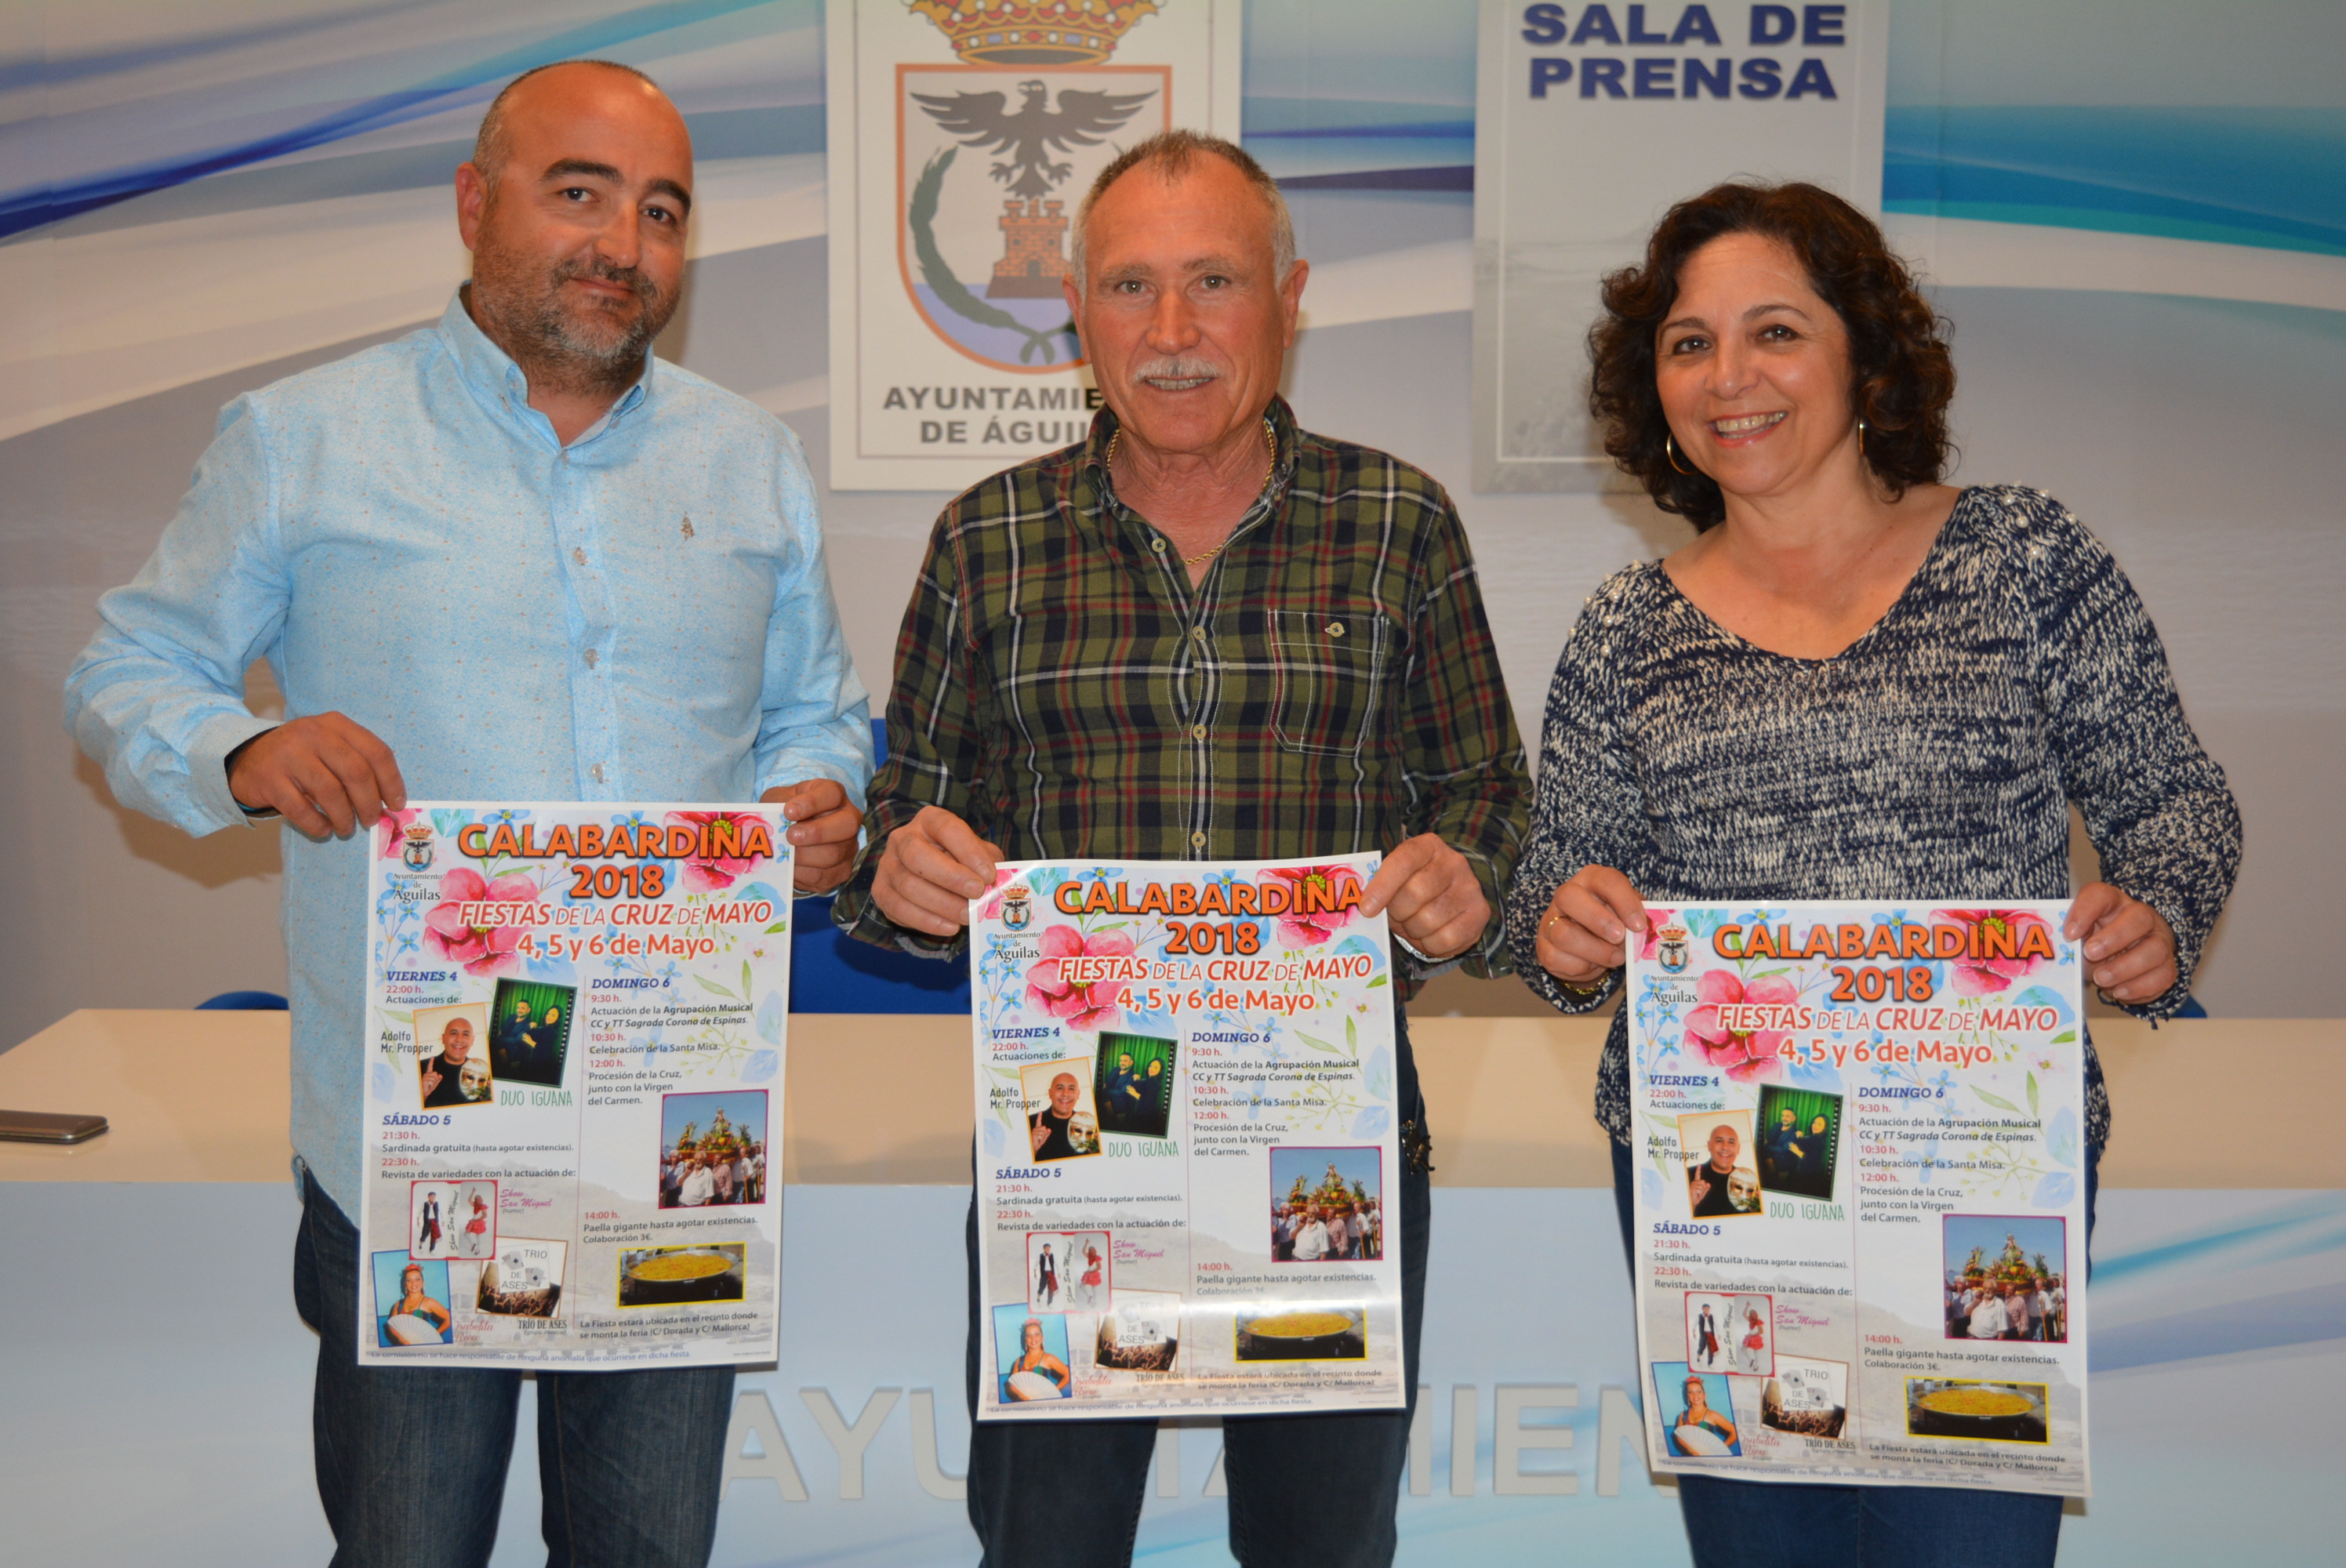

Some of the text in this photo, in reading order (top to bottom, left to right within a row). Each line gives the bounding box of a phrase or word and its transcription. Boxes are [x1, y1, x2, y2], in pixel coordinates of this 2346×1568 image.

[1522, 3, 1846, 45] SALA DE
[1530, 58, 1838, 99] PRENSA
[884, 387, 1106, 410] AYUNTAMIE
[921, 421, 967, 443] DE
[458, 823, 773, 858] CALABARDINA
[569, 864, 665, 898] 2018
[1055, 877, 1364, 916] CALABARDINA
[459, 902, 772, 925] FIESTAS DE LA CRUZ DE MAYO
[1165, 921, 1260, 955] 2018
[1713, 924, 2054, 960] CALABARDINA
[518, 934, 714, 960] 4, 5 y 6 de Mayo
[1060, 956, 1371, 981] FIESTAS DE LA CRUZ DE MAYO
[387, 971, 457, 981] VIERNES 4
[592, 978, 670, 989] DOMINGO 6
[1831, 966, 1933, 1001] 2018
[1118, 988, 1314, 1014] 4, 5 y 6 de Mayo
[1719, 1007, 2057, 1030] FIESTAS DE LA CRUZ DE MAYO
[381, 1032, 411, 1041] Adolfo
[993, 1027, 1060, 1039] VIERNES 4
[1192, 1033, 1270, 1043] DOMINGO 6
[381, 1044, 434, 1055] Mr. Propper
[1780, 1039, 1992, 1067] 4, 5 y 6 de Mayo
[1266, 1060, 1320, 1069] Agrupación
[1324, 1059, 1359, 1068] Musical
[1649, 1075, 1720, 1087] VIERNES 4
[501, 1091, 572, 1106] DUO IGUANA
[990, 1088, 1019, 1098] Adolfo
[1678, 1090, 1687, 1098] h.
[1858, 1087, 1944, 1098] DOMINGO 6
[990, 1100, 1040, 1110] Mr. Propper
[1193, 1098, 1247, 1106] Celebración
[1274, 1098, 1300, 1106] Santa
[1302, 1098, 1327, 1106] Misa.
[1650, 1100, 1725, 1109] Actuaciones de:
[1859, 1104, 1891, 1112] 9:30 h.
[383, 1112, 451, 1125] SÁBADO 5
[1647, 1137, 1676, 1146] Adolfo
[1109, 1141, 1178, 1157] DUO IGUANA
[1648, 1149, 1699, 1161] Mr. Propper
[432, 1170, 482, 1178] variedades
[504, 1169, 512, 1178] la
[997, 1167, 1061, 1179] SÁBADO 5
[500, 1189, 524, 1198] Show
[1861, 1187, 1908, 1196] Procesión
[1927, 1188, 1935, 1196] la
[1937, 1189, 1963, 1198] Cruz,
[500, 1199, 552, 1208] San Miguel
[997, 1196, 1043, 1205] Sardinada
[1046, 1196, 1081, 1206] gratuita
[1770, 1202, 1844, 1221] DUO IGUANA
[1654, 1221, 1720, 1235] SÁBADO 5
[525, 1250, 547, 1259] TRIO
[502, 1281, 528, 1290] ASES
[537, 1320, 547, 1329] DE
[1865, 1334, 1902, 1344] 14:00 h.
[1865, 1348, 2060, 1364] Paella gigante hasta agotar existencias.
[1865, 1359, 1924, 1370] Colaboración
